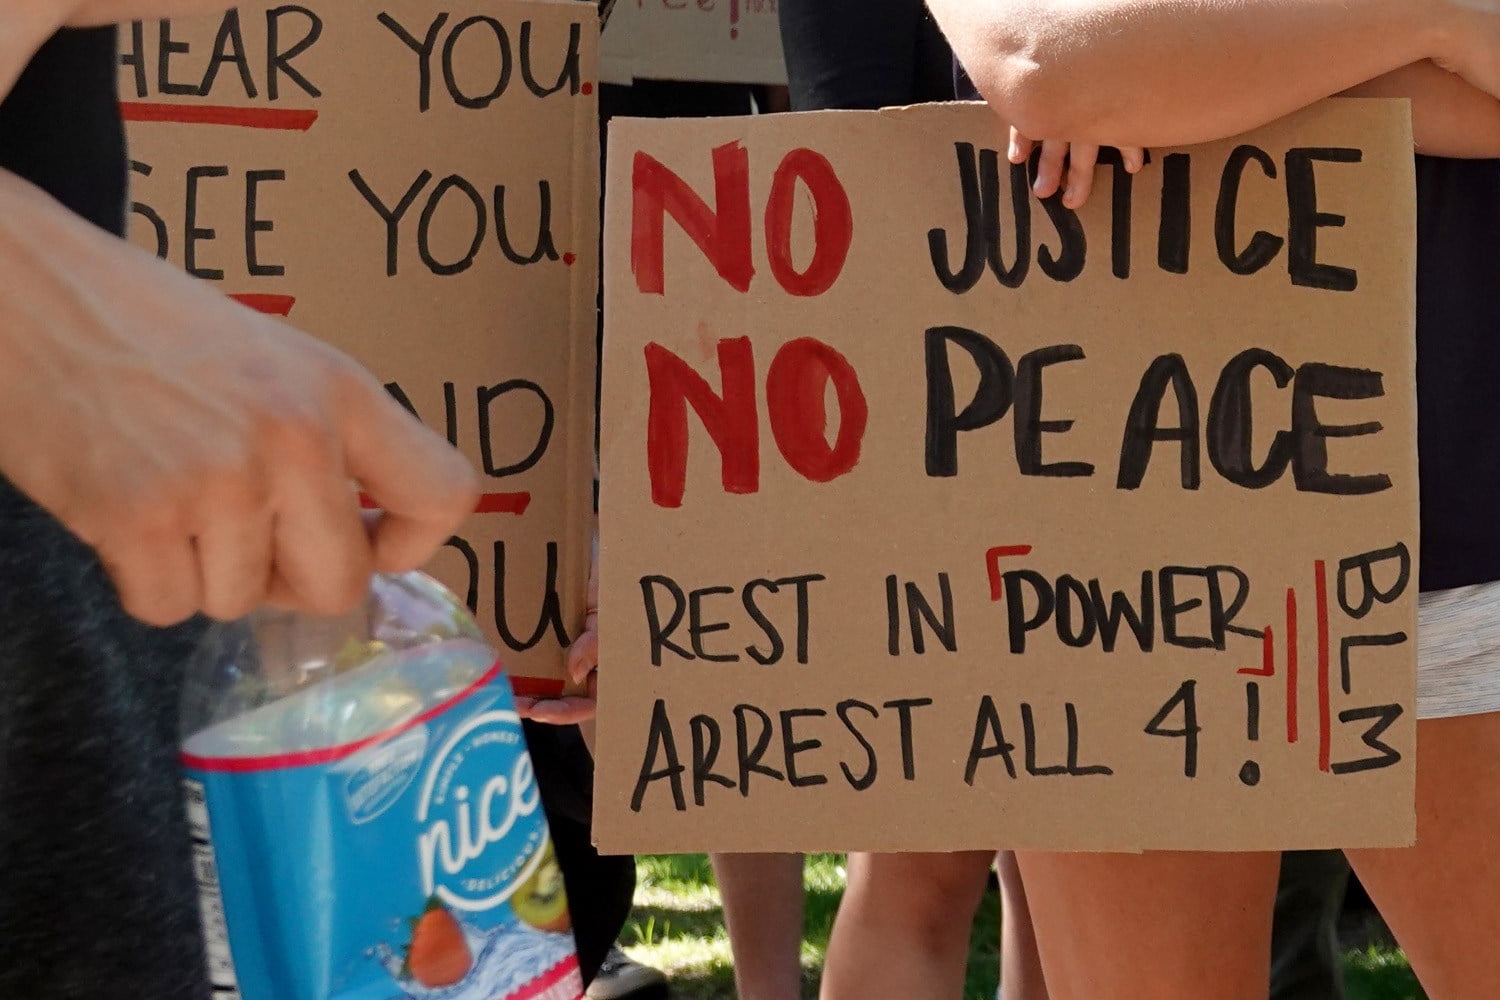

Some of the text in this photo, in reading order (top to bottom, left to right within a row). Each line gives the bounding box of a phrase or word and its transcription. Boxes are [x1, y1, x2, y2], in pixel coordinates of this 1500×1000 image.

[631, 140, 1365, 297] NO JUSTICE
[643, 325, 1394, 508] NO PEACE
[639, 564, 1268, 667] REST IN POWER
[1328, 541, 1412, 777] BLM
[418, 751, 540, 898] nice
[630, 697, 933, 812] ARREST
[963, 694, 1113, 787] ALL
